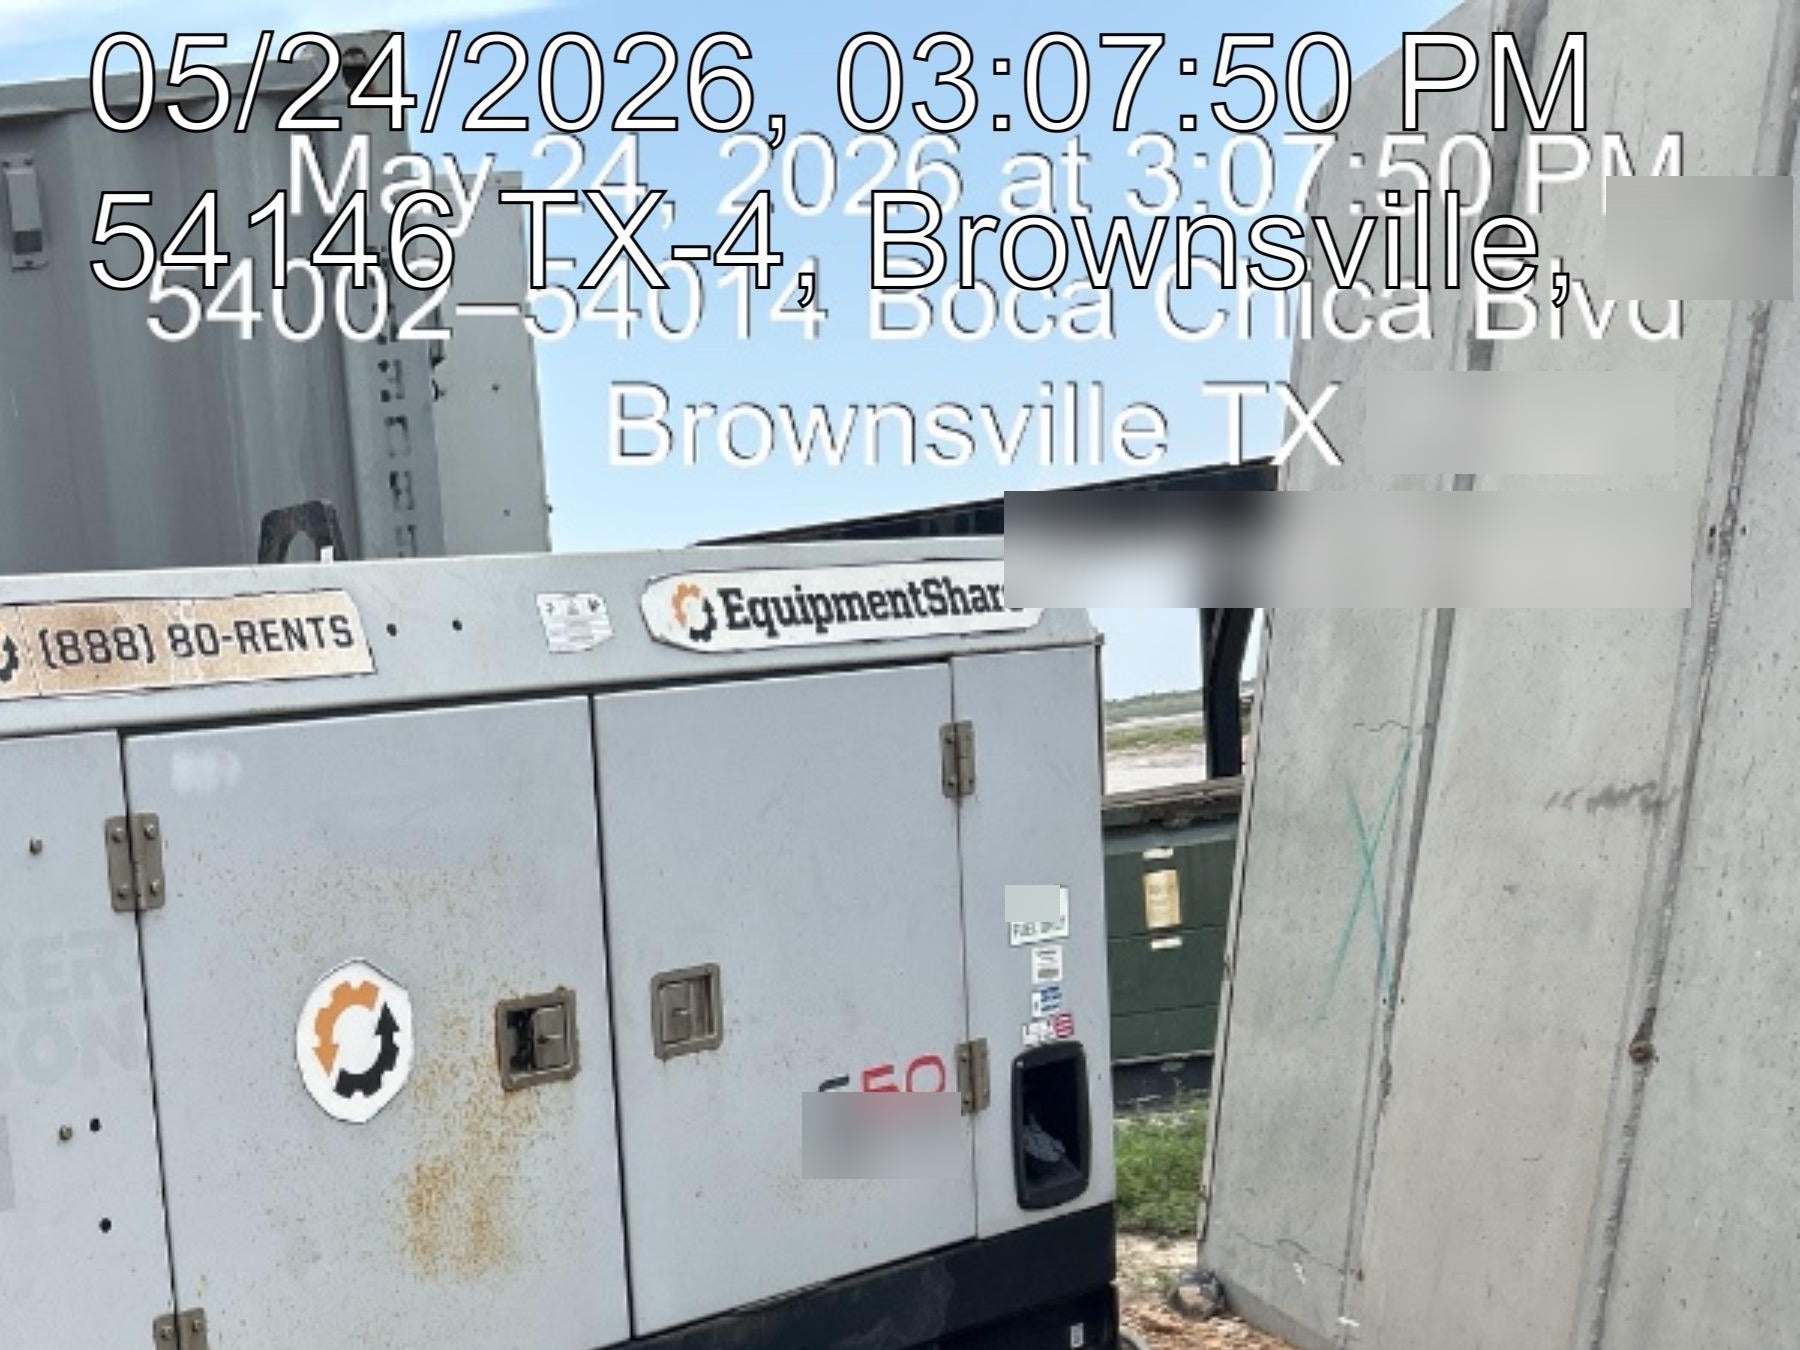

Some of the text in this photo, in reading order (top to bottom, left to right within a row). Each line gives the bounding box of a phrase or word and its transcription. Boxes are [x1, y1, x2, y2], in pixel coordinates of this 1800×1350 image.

[718, 576, 1024, 634] EquipmentShar
[39, 614, 354, 669] (888) 80-RENTS
